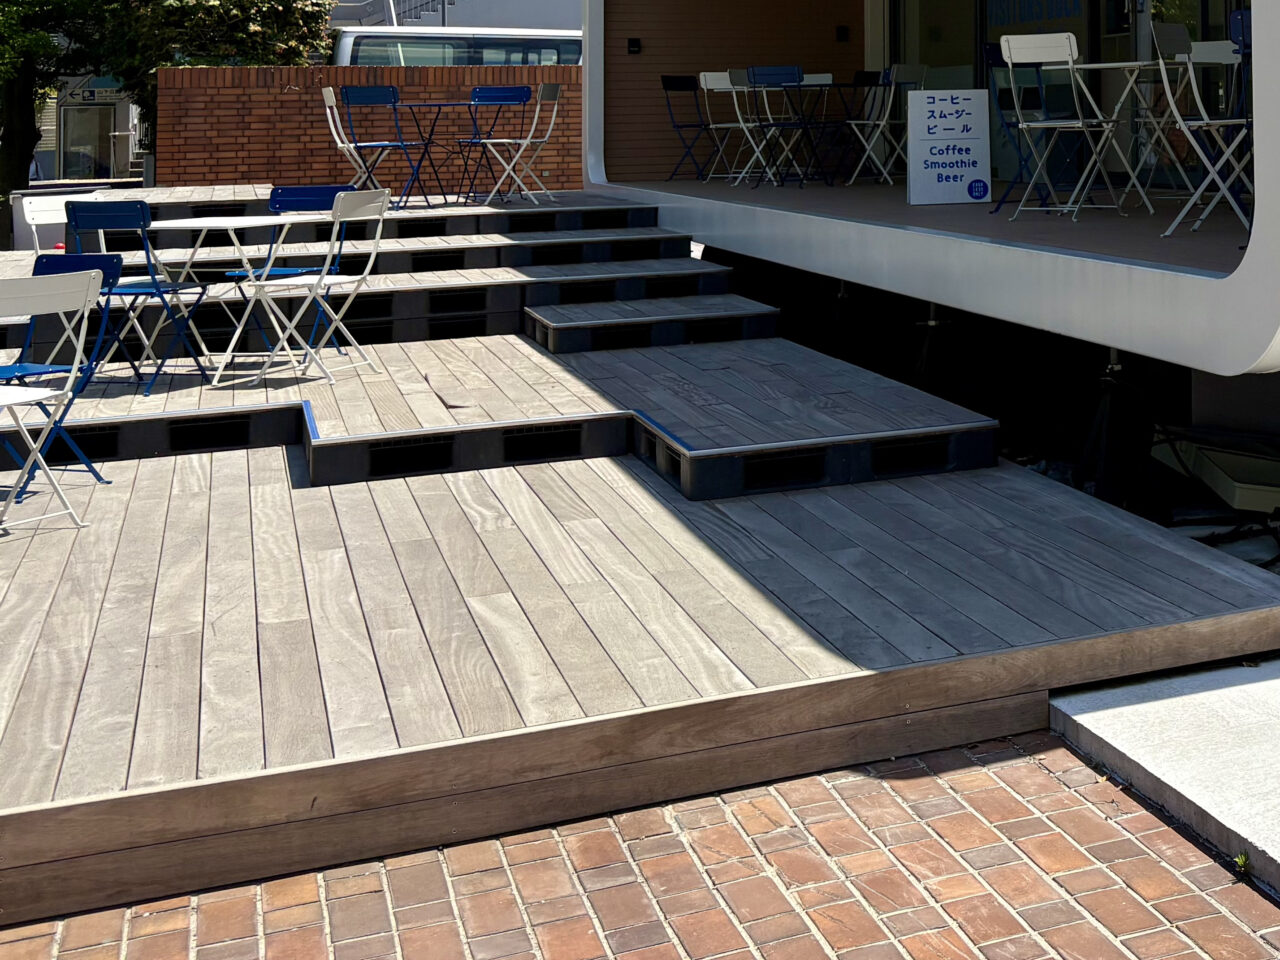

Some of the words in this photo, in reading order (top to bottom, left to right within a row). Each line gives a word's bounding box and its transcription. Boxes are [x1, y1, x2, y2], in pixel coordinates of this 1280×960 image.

[926, 94, 972, 105] コーヒー
[927, 109, 972, 119] スムージー
[927, 124, 972, 134] ビール
[929, 144, 971, 156] Coffee
[923, 159, 978, 169] Smoothie
[937, 173, 965, 183] Beer
